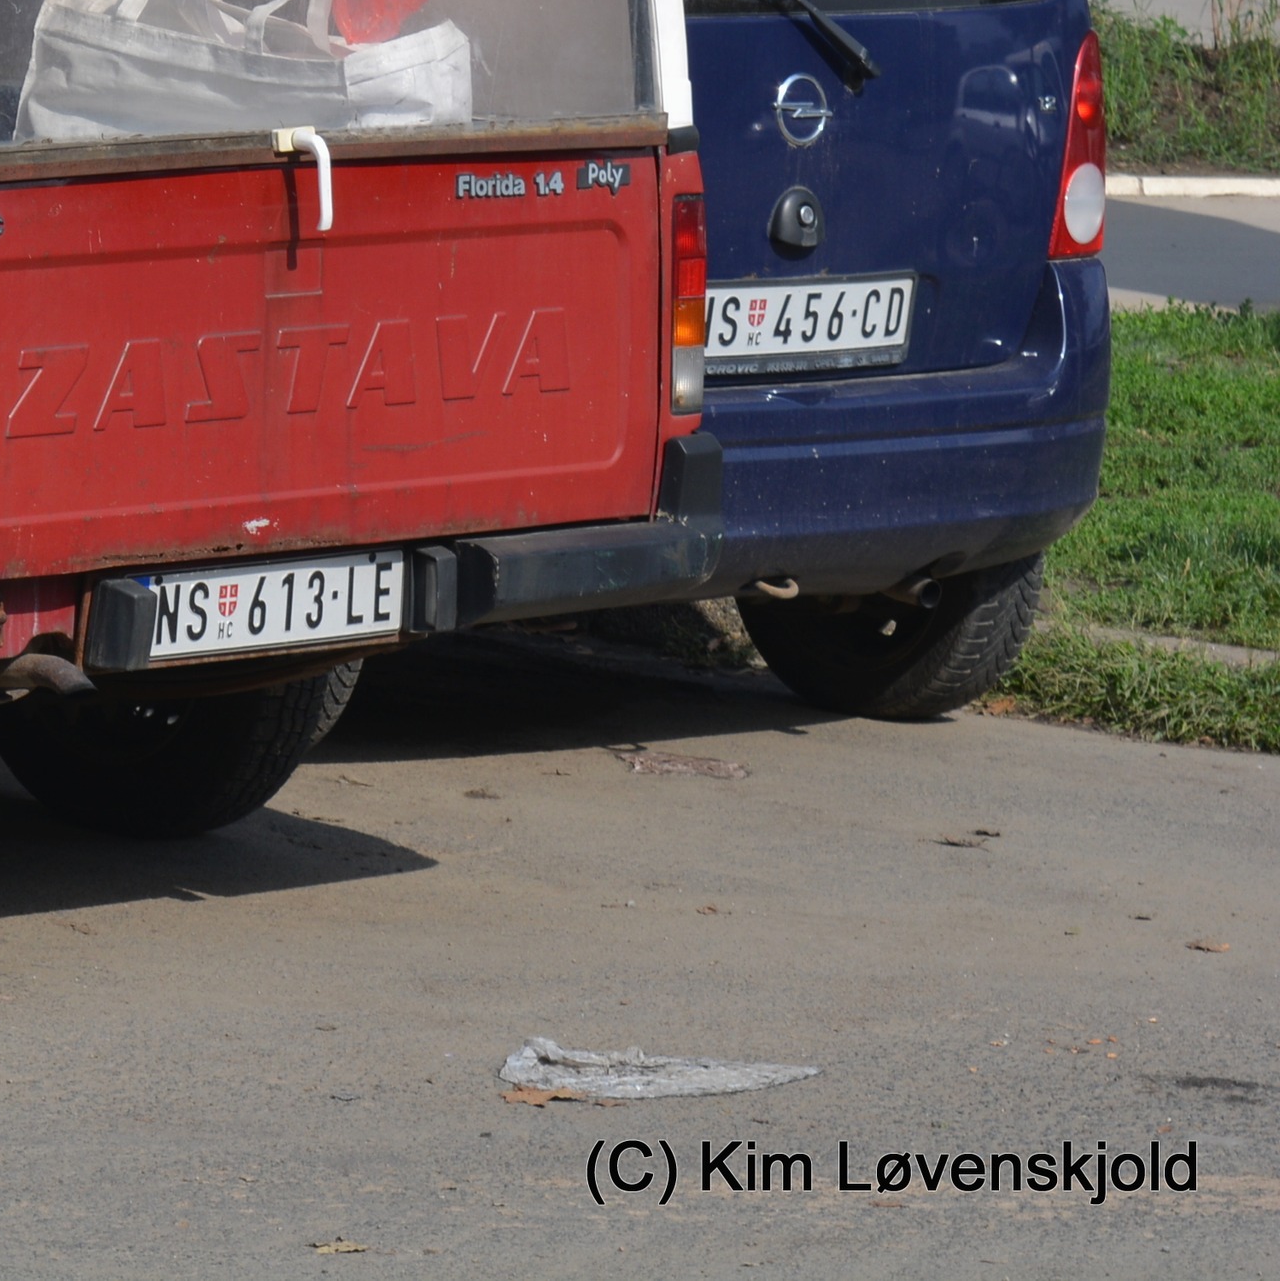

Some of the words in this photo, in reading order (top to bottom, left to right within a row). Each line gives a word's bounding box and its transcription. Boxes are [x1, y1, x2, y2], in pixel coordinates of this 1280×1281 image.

[456, 173, 526, 198] Florida
[535, 171, 565, 196] 1.4
[588, 162, 624, 189] Poly
[5, 306, 571, 440] ZASTAVA
[156, 581, 210, 645] NS
